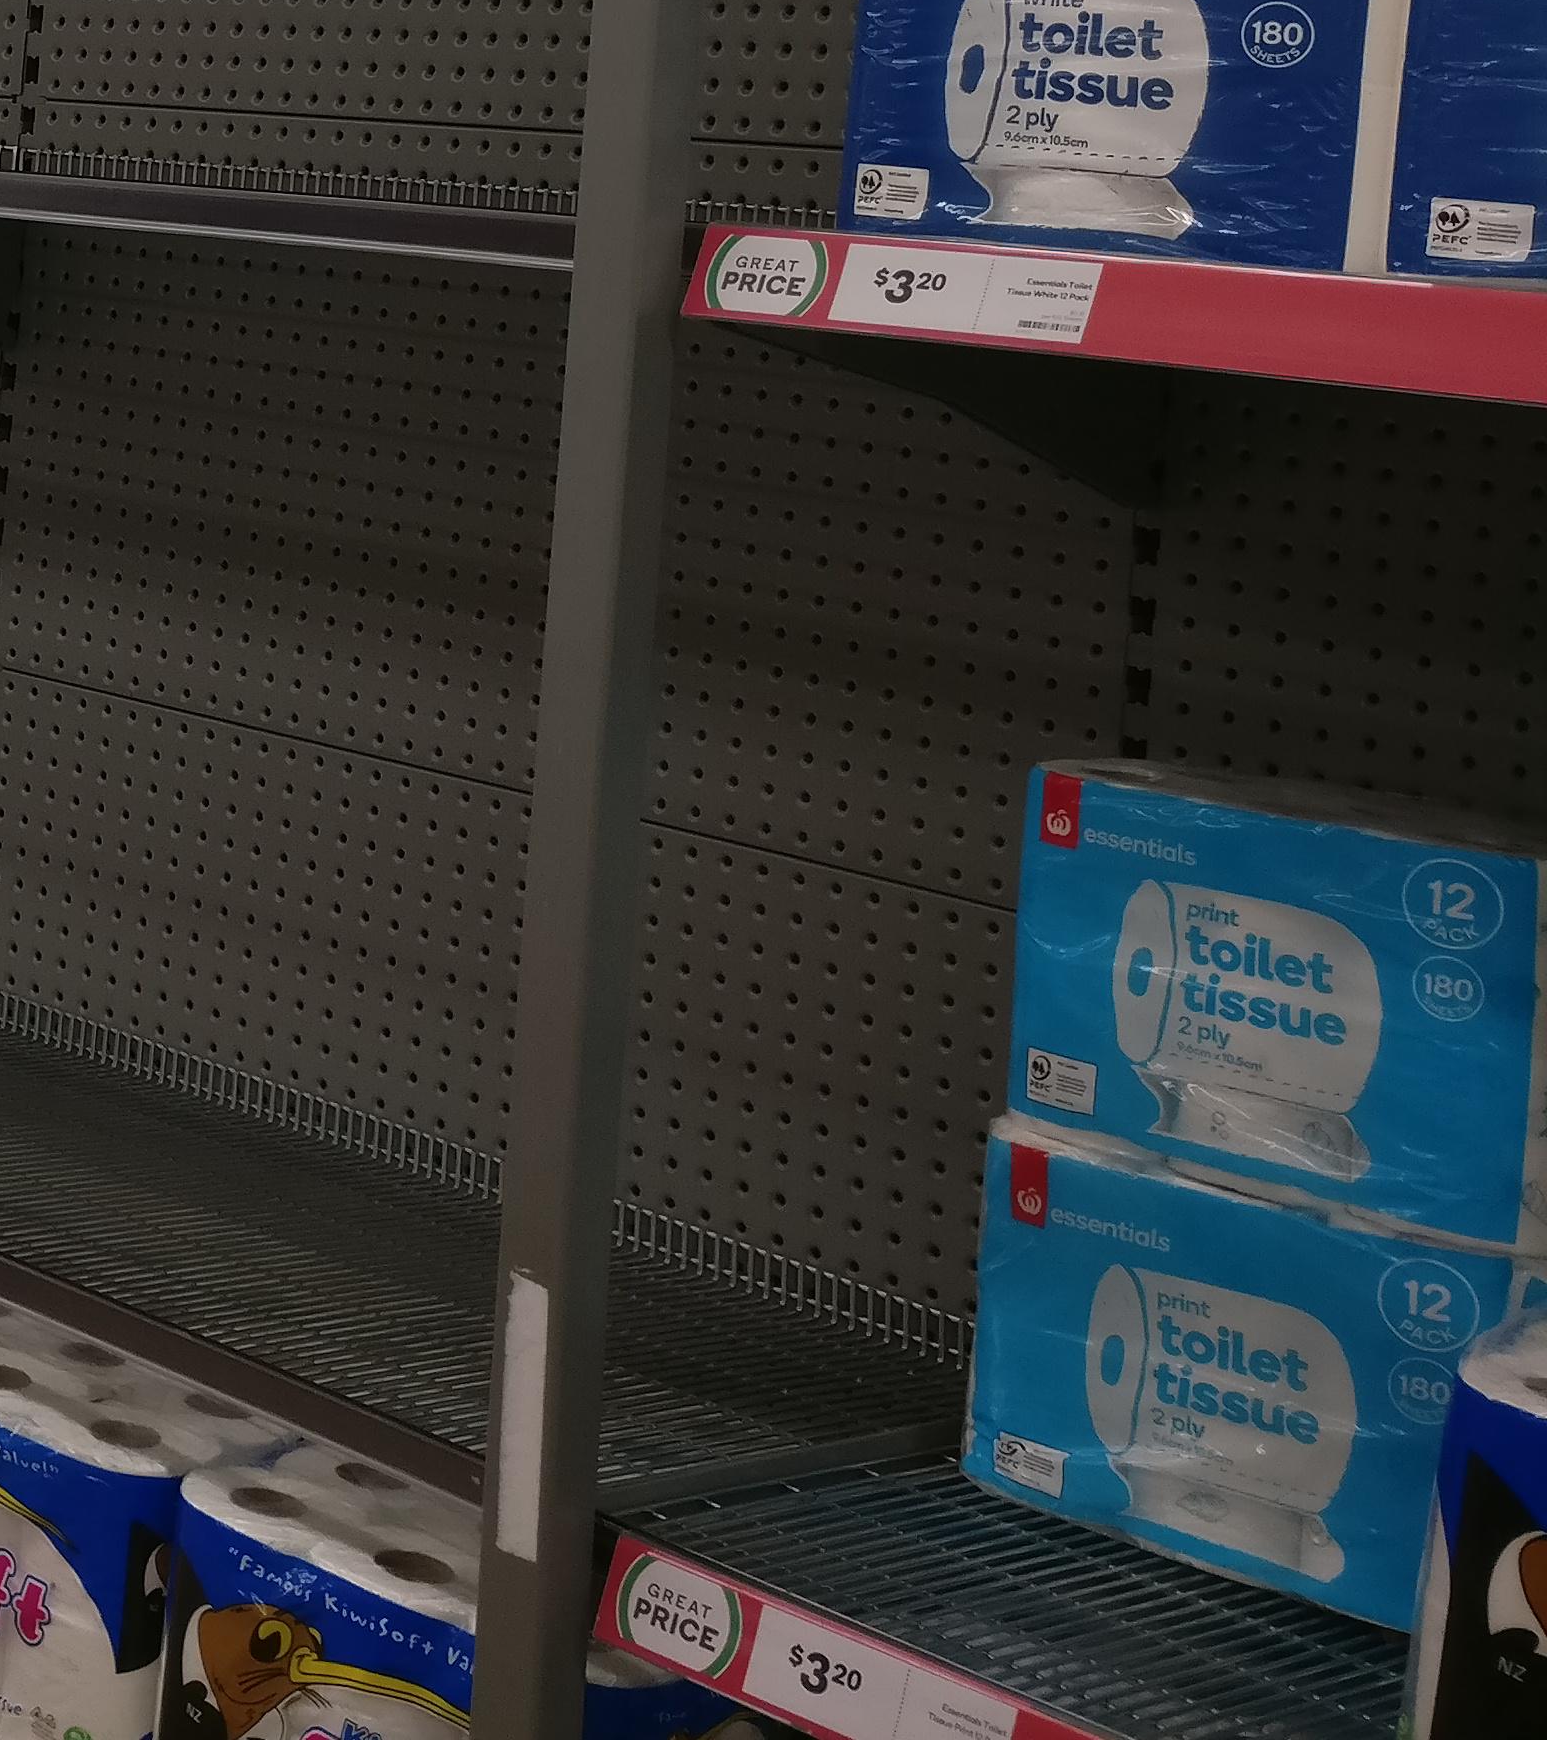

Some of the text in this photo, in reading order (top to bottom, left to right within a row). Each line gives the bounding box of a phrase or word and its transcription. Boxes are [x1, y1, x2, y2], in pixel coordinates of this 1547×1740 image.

[1018, 10, 1164, 62] toilet
[1251, 20, 1303, 49] 180
[1250, 44, 1305, 65] SHEETS
[1011, 56, 1175, 112] tissue
[1006, 104, 1059, 133] 2 ply
[1004, 129, 1089, 150] 9.6cm 10.5cm
[857, 195, 881, 205] PEFC
[1432, 233, 1469, 245] PEFC
[735, 255, 800, 273] GREAT
[720, 271, 807, 297] PRICE
[1007, 287, 1089, 301] Tissue White Pack
[1027, 277, 1093, 290] Essentials Toilet
[1083, 826, 1198, 866] essentials
[1186, 900, 1240, 928] print
[1427, 878, 1477, 921] 12
[1423, 916, 1480, 943] PACK
[1184, 923, 1334, 995] toilet
[1423, 973, 1474, 1002] 180
[1179, 972, 1347, 1046] tissue
[1178, 1016, 1231, 1049] 2 ply
[1051, 1205, 1171, 1253] essentials
[1156, 1290, 1213, 1319] print
[1403, 1277, 1454, 1324] 12
[1400, 1316, 1456, 1345] PACK
[1157, 1313, 1309, 1392] toilet
[1153, 1362, 1321, 1445] tissue
[1397, 1373, 1452, 1405] 180
[1150, 1407, 1206, 1440] 2 ply
[647, 1582, 713, 1619] GREAT
[324, 1593, 434, 1656] KiwiSoft
[633, 1597, 720, 1654] PRICE
[1497, 1655, 1527, 1683] NZ
[185, 1701, 202, 1724] NZ
